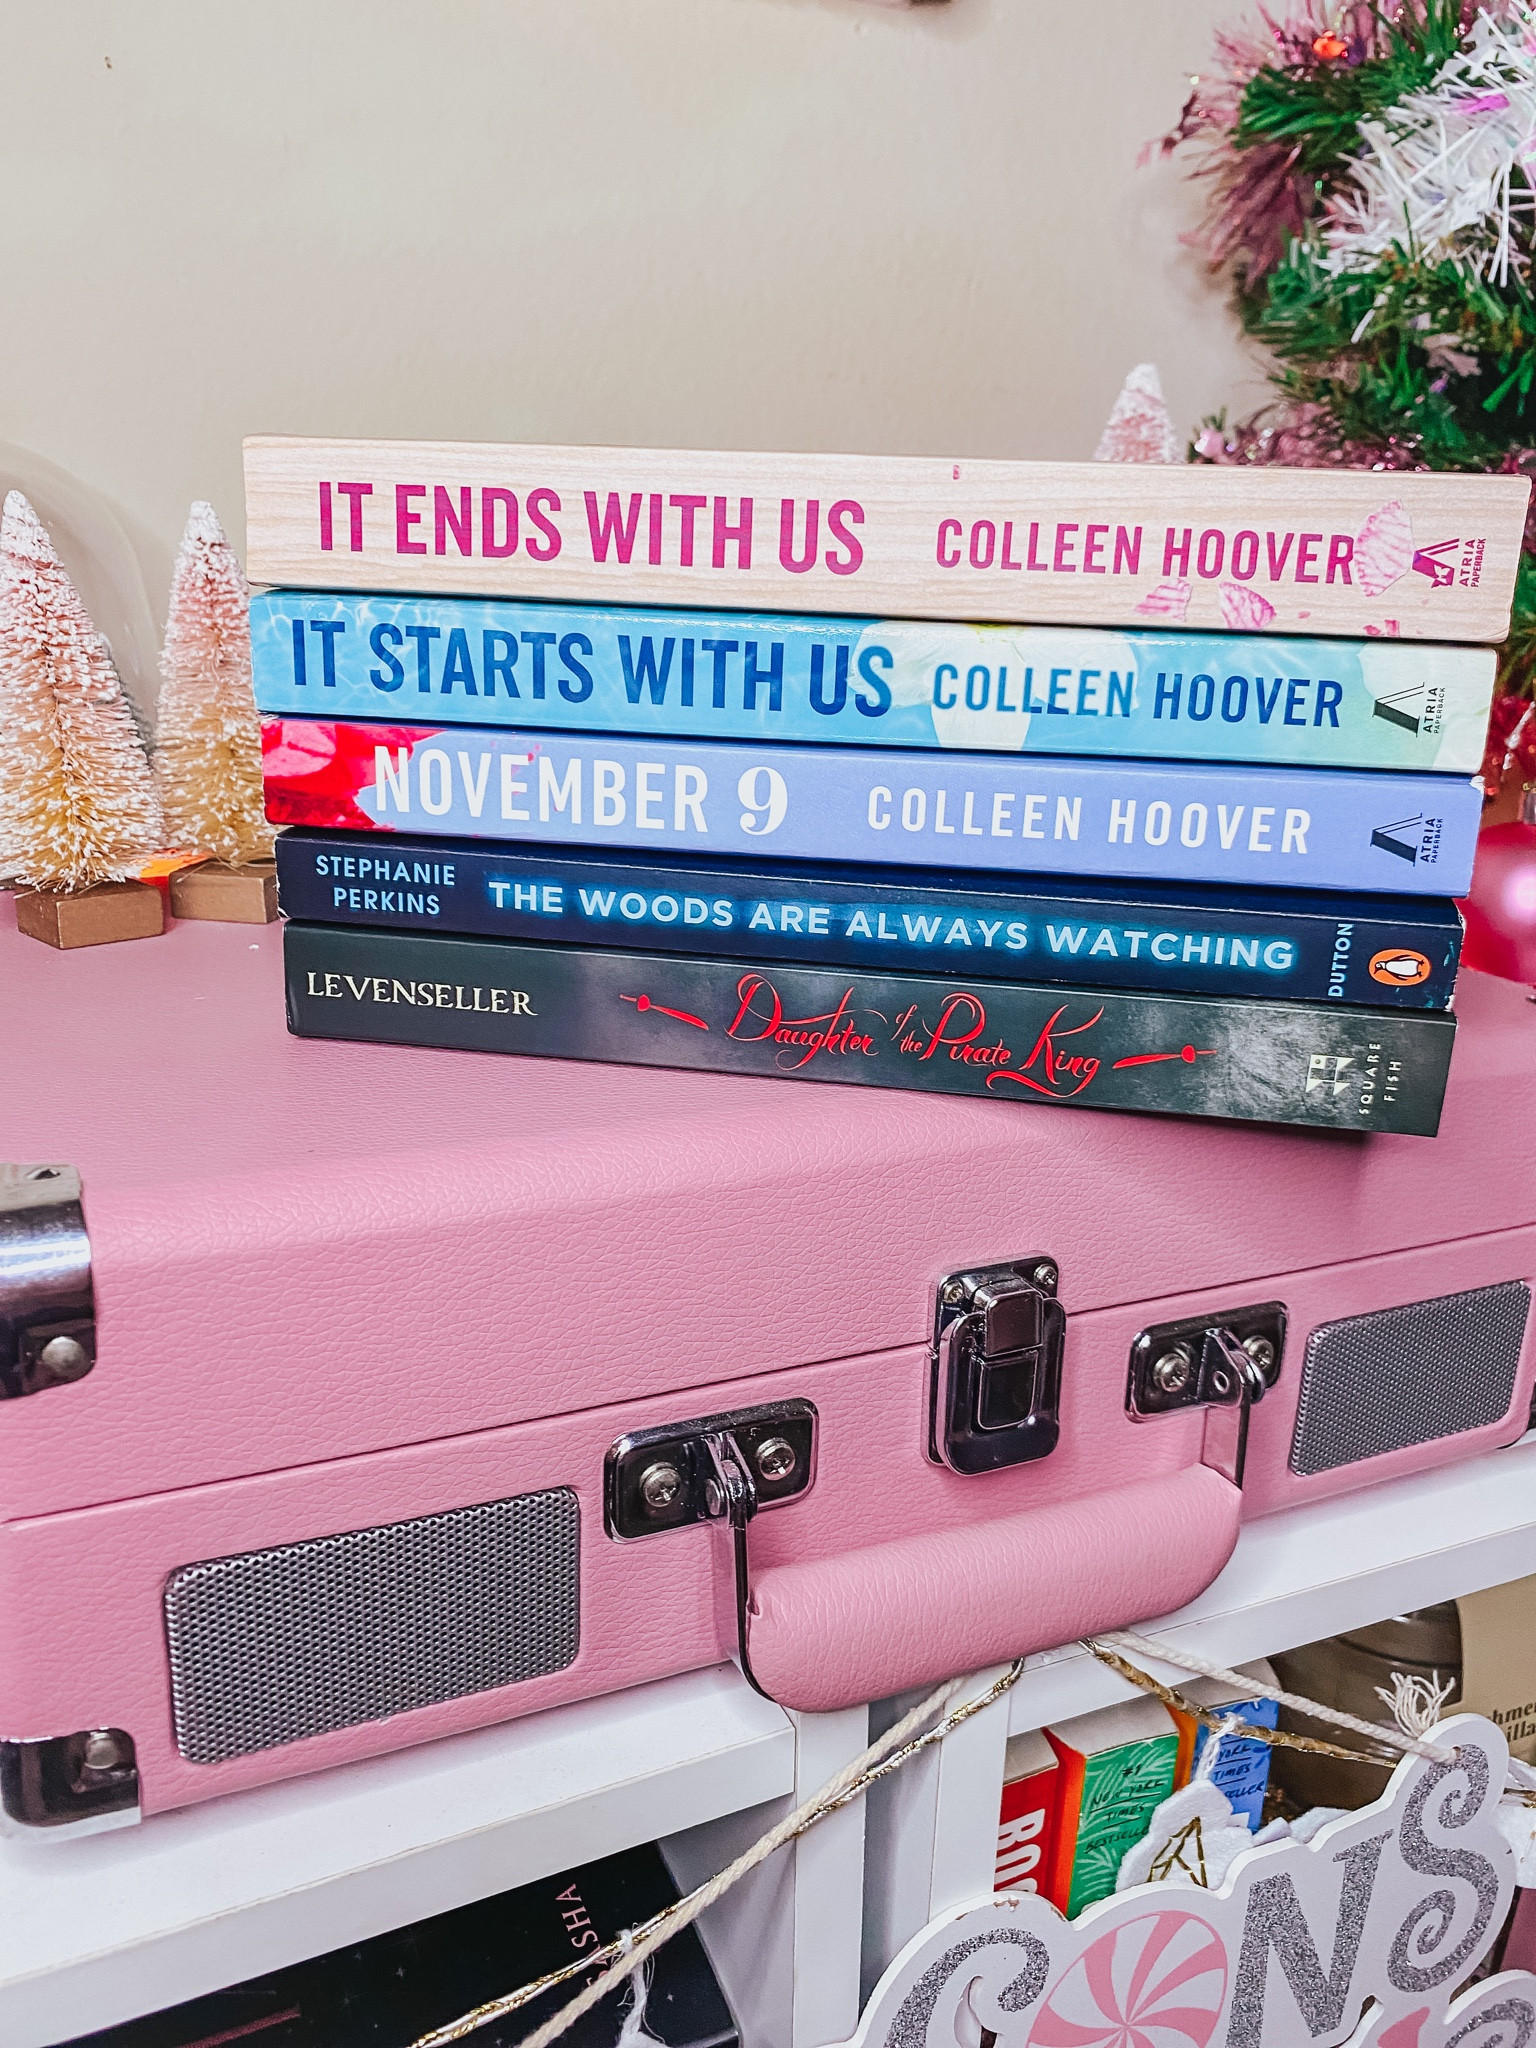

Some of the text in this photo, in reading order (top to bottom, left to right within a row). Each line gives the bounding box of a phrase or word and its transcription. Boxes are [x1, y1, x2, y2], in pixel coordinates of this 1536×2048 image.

[318, 481, 866, 576] IT ENDS WITH US
[936, 518, 1355, 586] COLLEEN HOOVER
[1459, 538, 1477, 587] ATRIA
[1470, 537, 1487, 588] PAPERBACK
[291, 619, 895, 718] IT STARTS WITH US
[932, 662, 1344, 729] COLLEEN HOOVER
[1422, 686, 1440, 734] ATRIA
[1432, 686, 1446, 735] PAPERBACK
[373, 745, 789, 836] NOVEMBER 9
[867, 785, 1312, 855] COLLEEN HOOVER
[1419, 817, 1436, 864] ATRIA
[1430, 817, 1444, 865] PAPERBACK
[315, 854, 456, 887] STEPHANIE
[332, 888, 441, 916] PERKINS
[489, 880, 1294, 971] THE WOODS ARE ALWAYS WATCHING
[1327, 922, 1356, 998] DUTTON
[306, 971, 539, 1017] LEVENSELLER
[724, 972, 1106, 1099] Daughter of the Pirate King
[1358, 1042, 1382, 1115] SQUARE
[1383, 1060, 1403, 1102] FISH
[1122, 1763, 1141, 1777] #1
[1213, 1762, 1252, 1780] TIMES
[1105, 1801, 1145, 1821] TIMES
